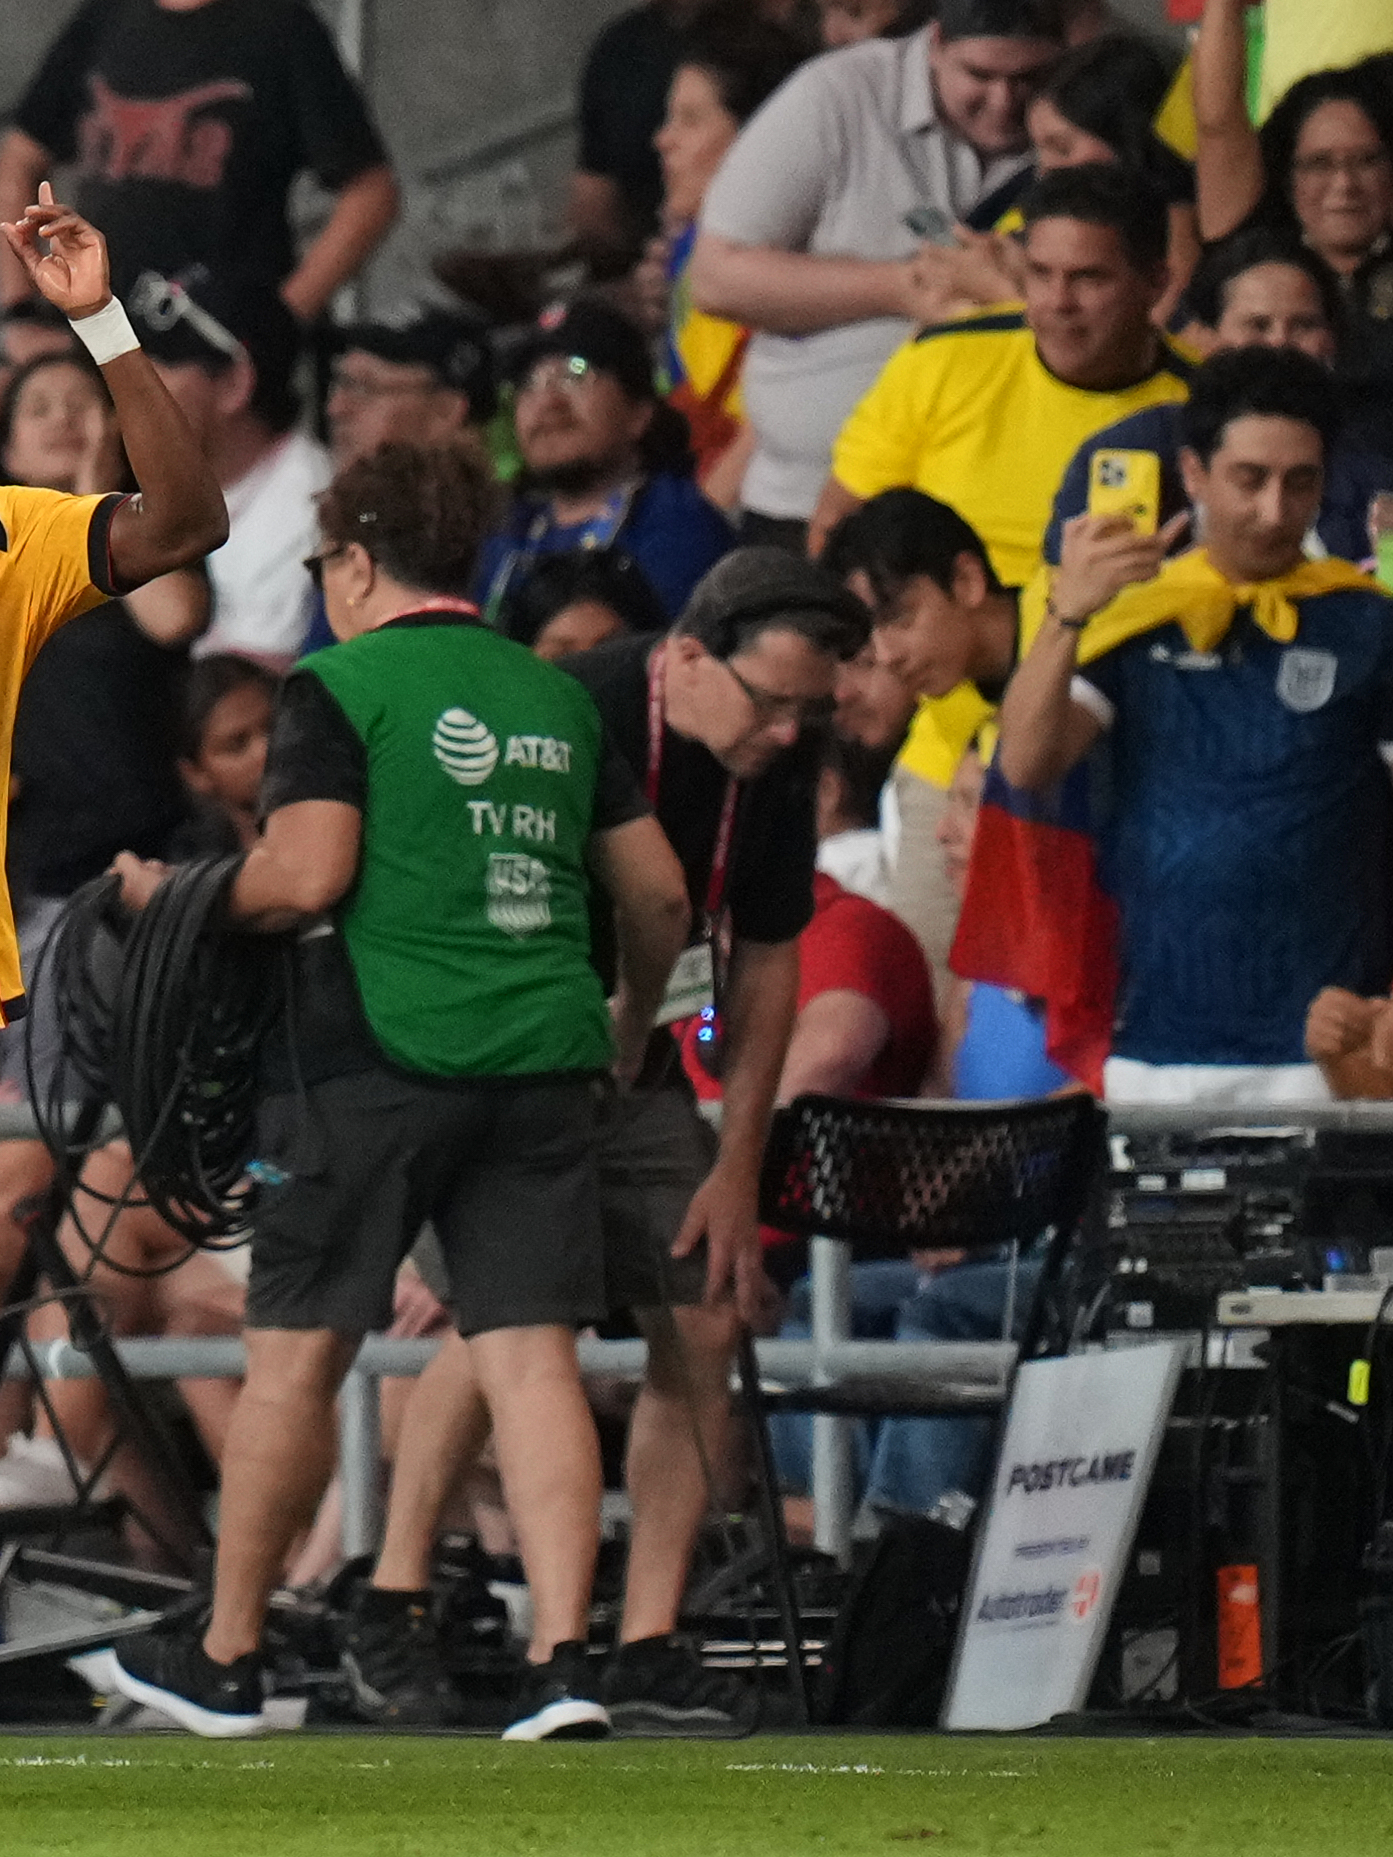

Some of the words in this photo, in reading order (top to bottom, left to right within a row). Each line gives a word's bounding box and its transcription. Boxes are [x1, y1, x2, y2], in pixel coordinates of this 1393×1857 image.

[505, 735, 571, 773] AT&T
[467, 800, 506, 836] TV
[513, 803, 556, 842] RH
